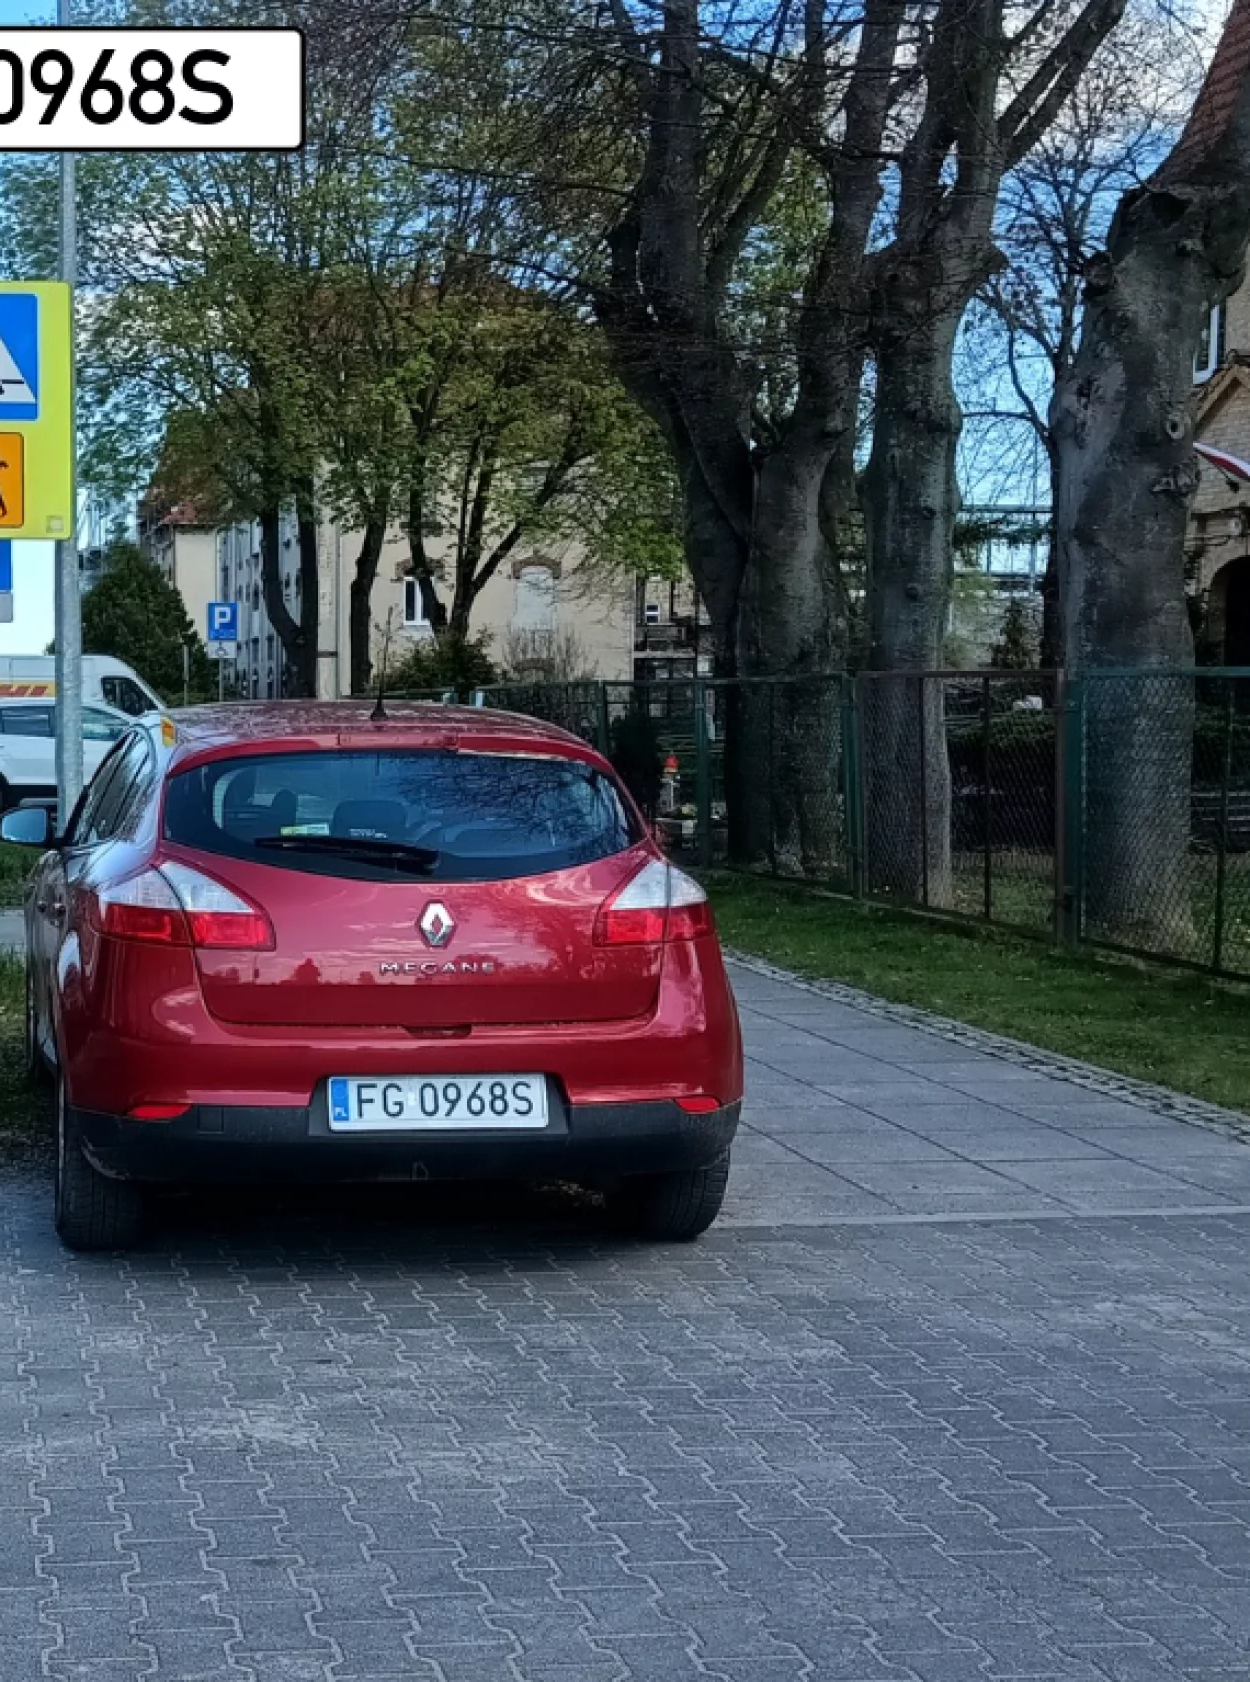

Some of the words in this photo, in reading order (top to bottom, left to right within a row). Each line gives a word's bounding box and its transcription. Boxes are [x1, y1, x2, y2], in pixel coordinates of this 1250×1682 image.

[214, 606, 231, 629] P
[356, 1083, 405, 1118] FG
[419, 1081, 534, 1117] 0968S
